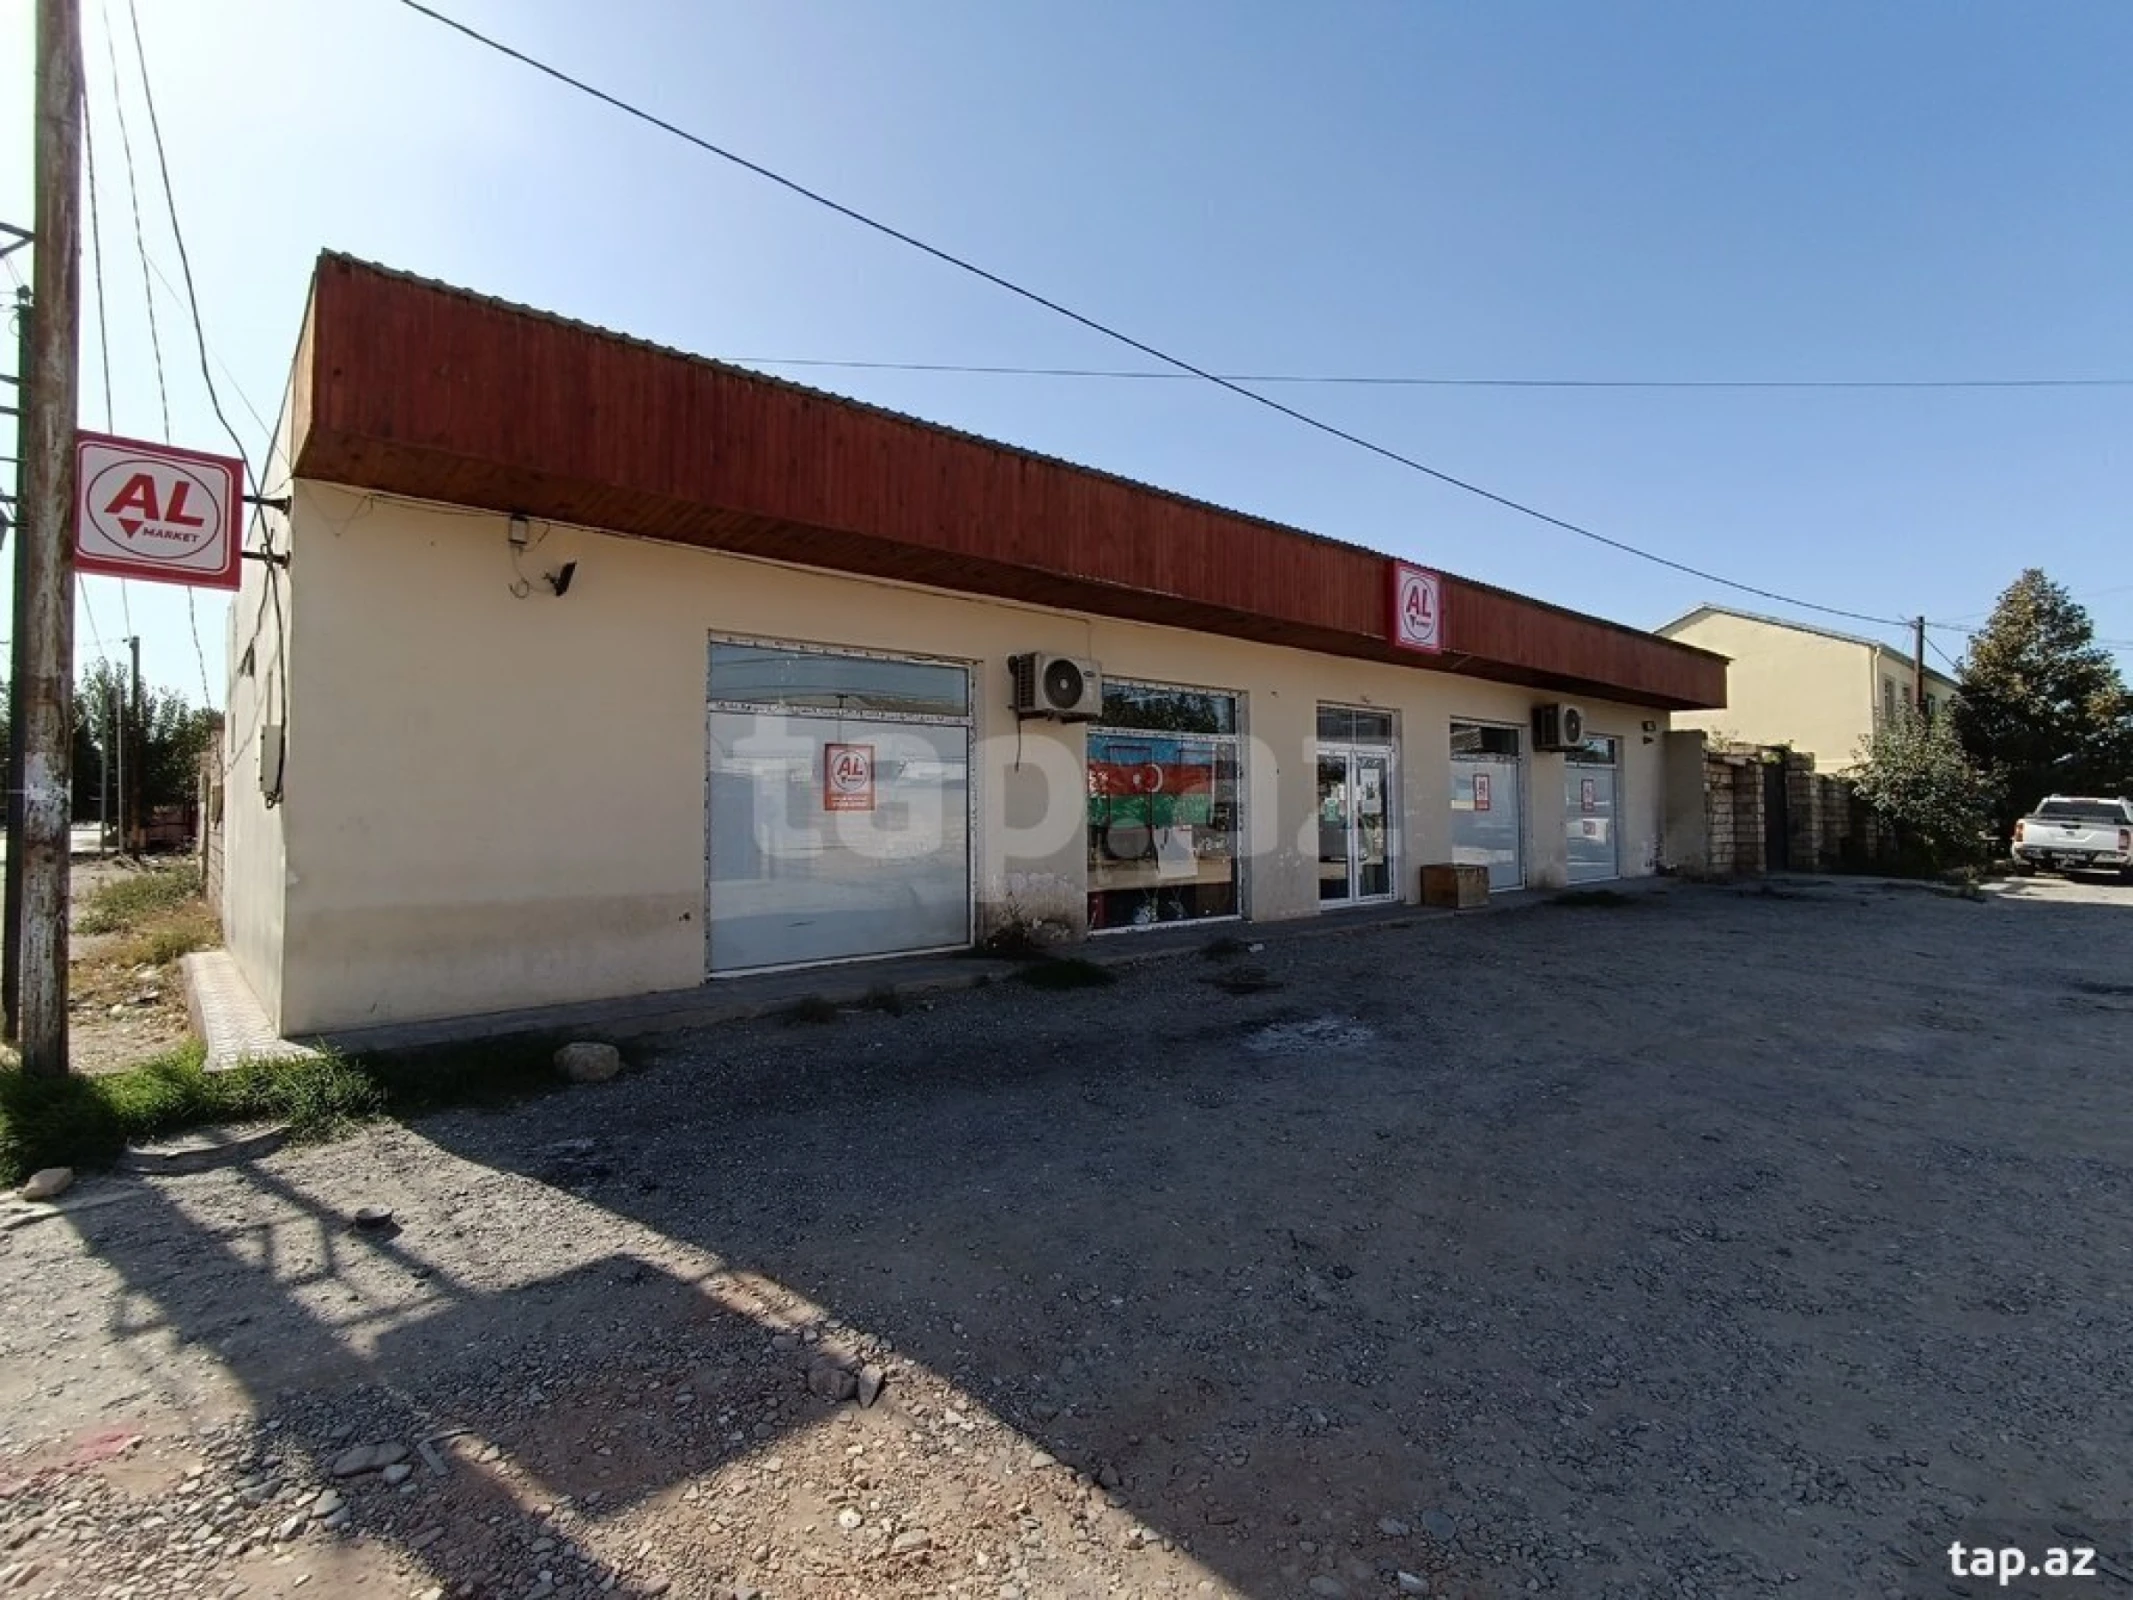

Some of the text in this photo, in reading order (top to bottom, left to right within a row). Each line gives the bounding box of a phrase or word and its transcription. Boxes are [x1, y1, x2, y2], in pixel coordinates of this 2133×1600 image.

[104, 473, 204, 527] AL
[143, 527, 200, 542] MARKET
[1406, 585, 1432, 617] AL
[837, 756, 863, 775] AL
